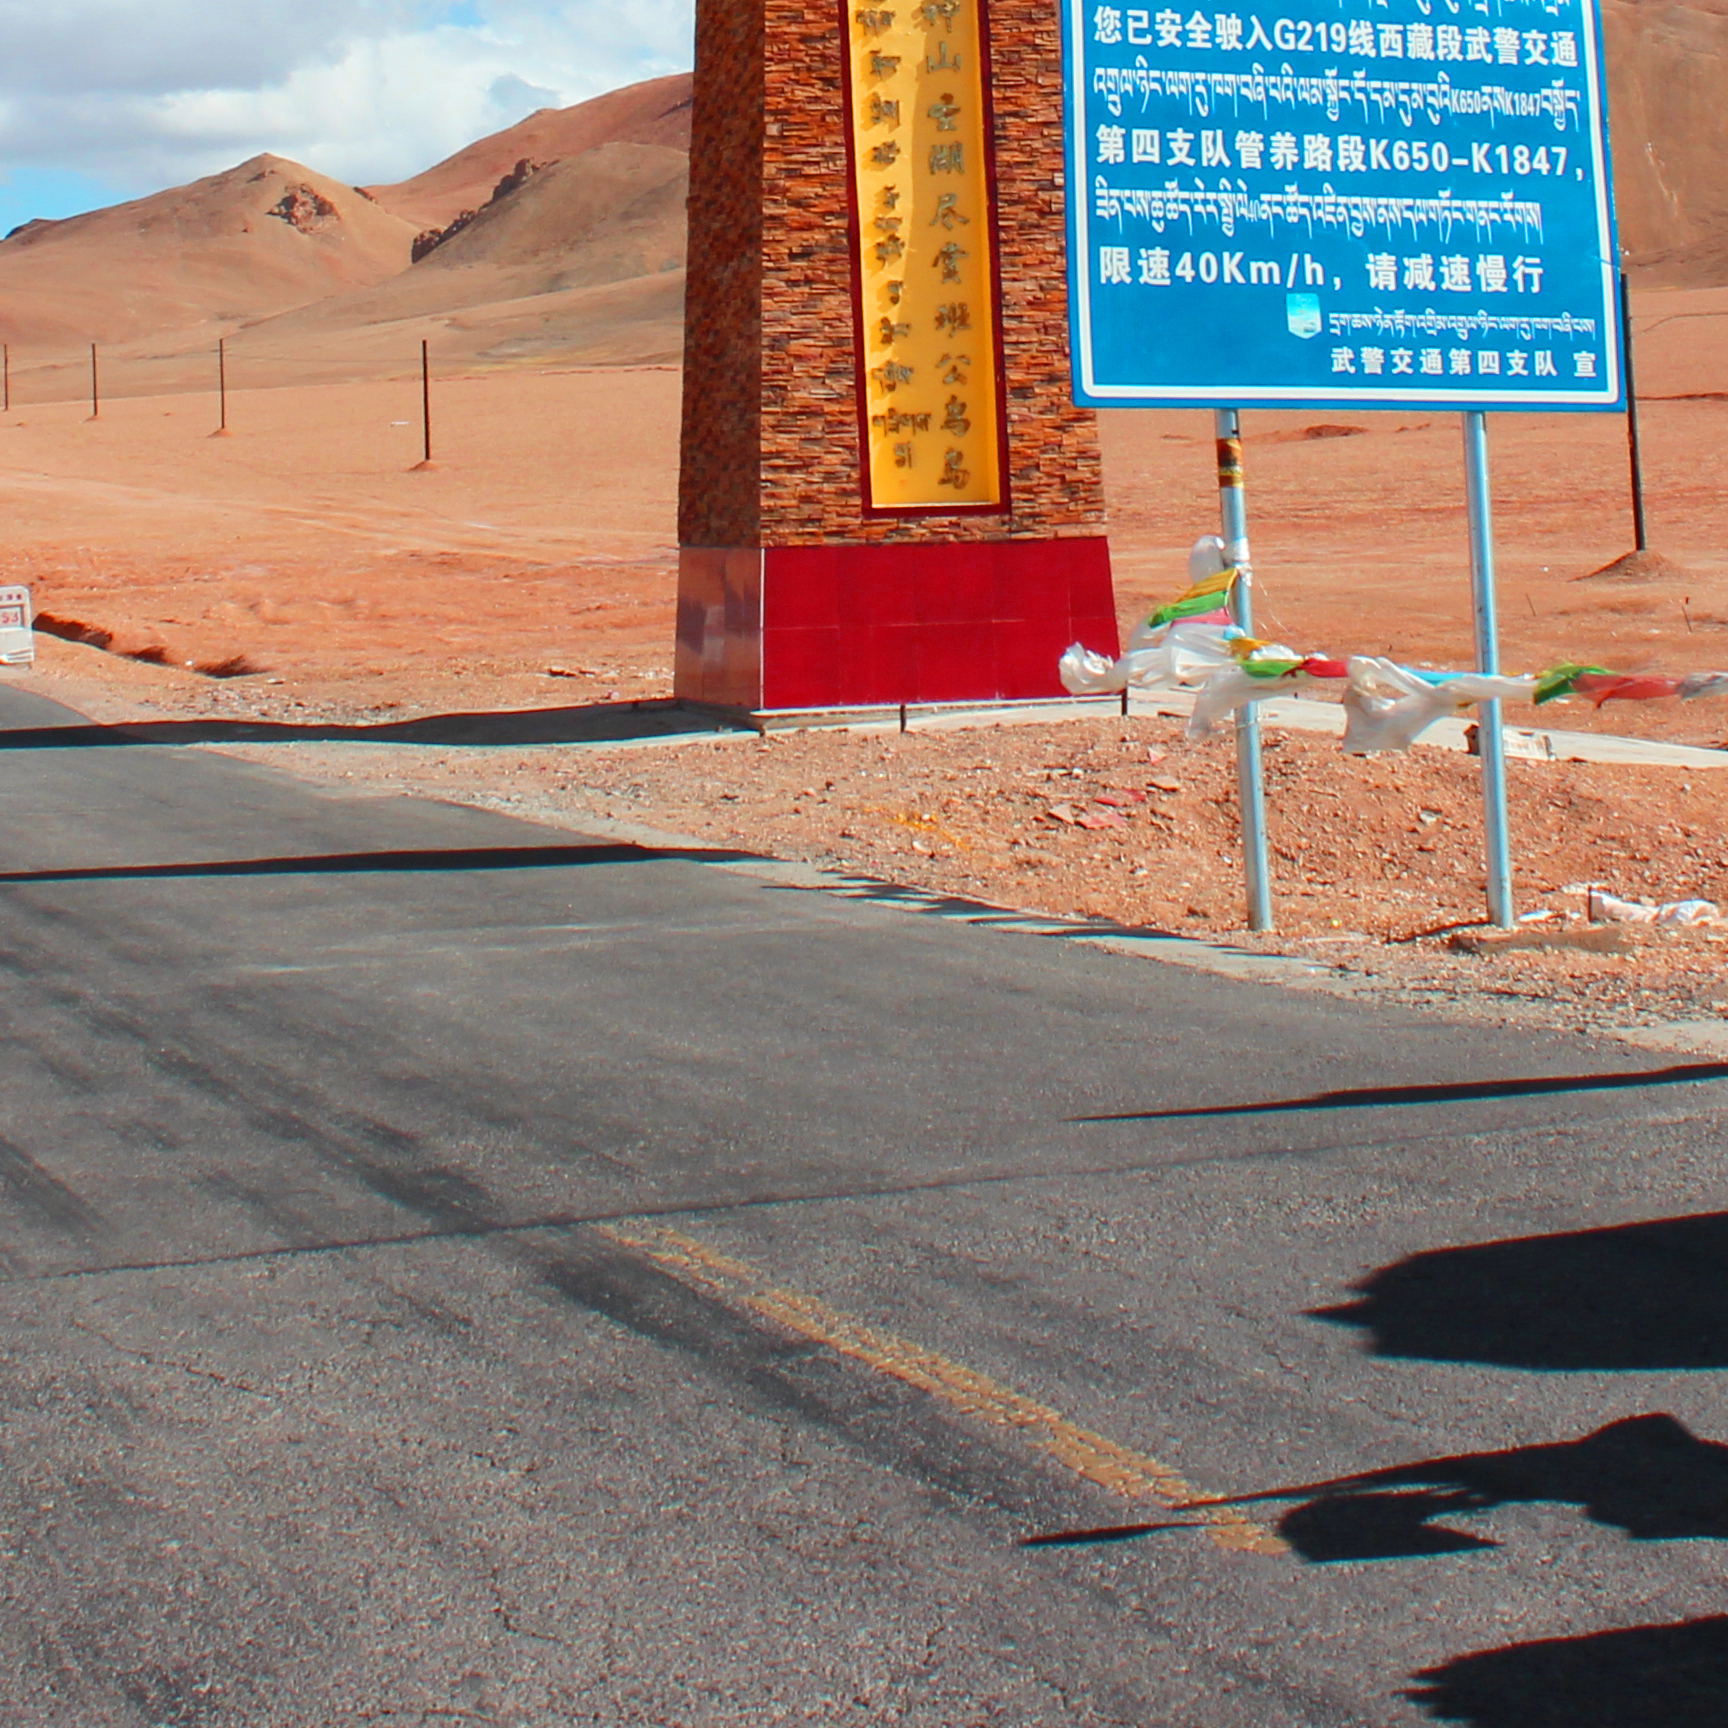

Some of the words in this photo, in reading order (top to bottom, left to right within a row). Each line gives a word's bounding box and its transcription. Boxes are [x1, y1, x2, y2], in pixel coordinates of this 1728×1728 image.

[1093, 6, 1579, 67] 您已安全驶入G219线西藏段武警交通
